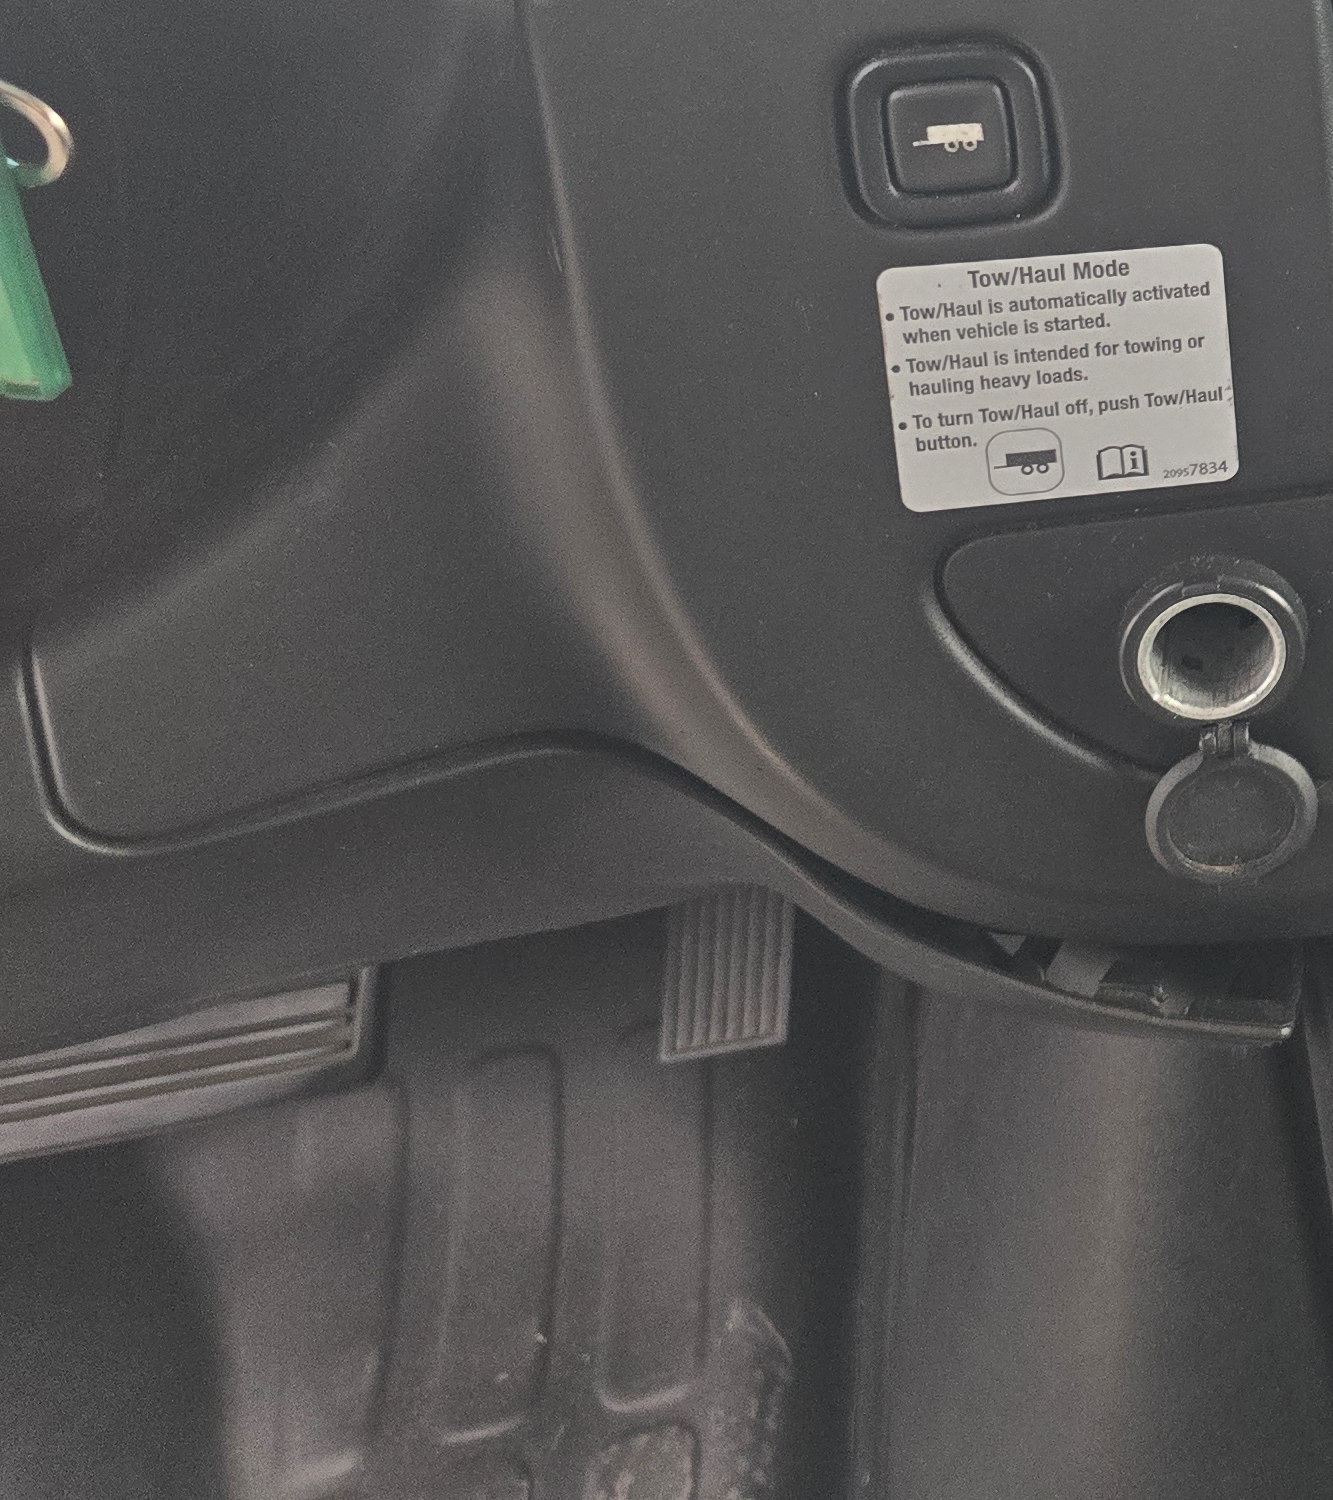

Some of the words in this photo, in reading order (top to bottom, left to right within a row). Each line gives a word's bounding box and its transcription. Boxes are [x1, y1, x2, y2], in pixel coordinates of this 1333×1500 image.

[968, 263, 1066, 289] Tow/Haul
[1073, 259, 1130, 280] Mode
[900, 300, 982, 322] Tow/Haul
[988, 299, 1004, 315] is
[1009, 287, 1126, 312] automatically
[1132, 282, 1210, 301] activated
[903, 327, 951, 344] when
[956, 321, 1018, 339] vehicle
[1024, 317, 1038, 334] is
[1044, 313, 1110, 332] started.
[906, 353, 988, 373] Tow/Haul
[994, 351, 1009, 366] is
[1014, 344, 1089, 364] intended
[1095, 341, 1119, 357] for
[1125, 338, 1182, 356] towing
[1188, 335, 1205, 349] or
[909, 376, 974, 396] hauling
[980, 373, 1030, 390] heavy
[1036, 369, 1088, 385] loads.
[913, 414, 932, 430] To
[937, 410, 973, 427] turn
[978, 403, 1059, 424] Tow/Haul
[1065, 400, 1093, 416] off,
[1099, 396, 1139, 415] push
[1144, 388, 1223, 408] Tow/Haul
[916, 433, 977, 451] button.
[1163, 460, 1228, 479] 20957834
